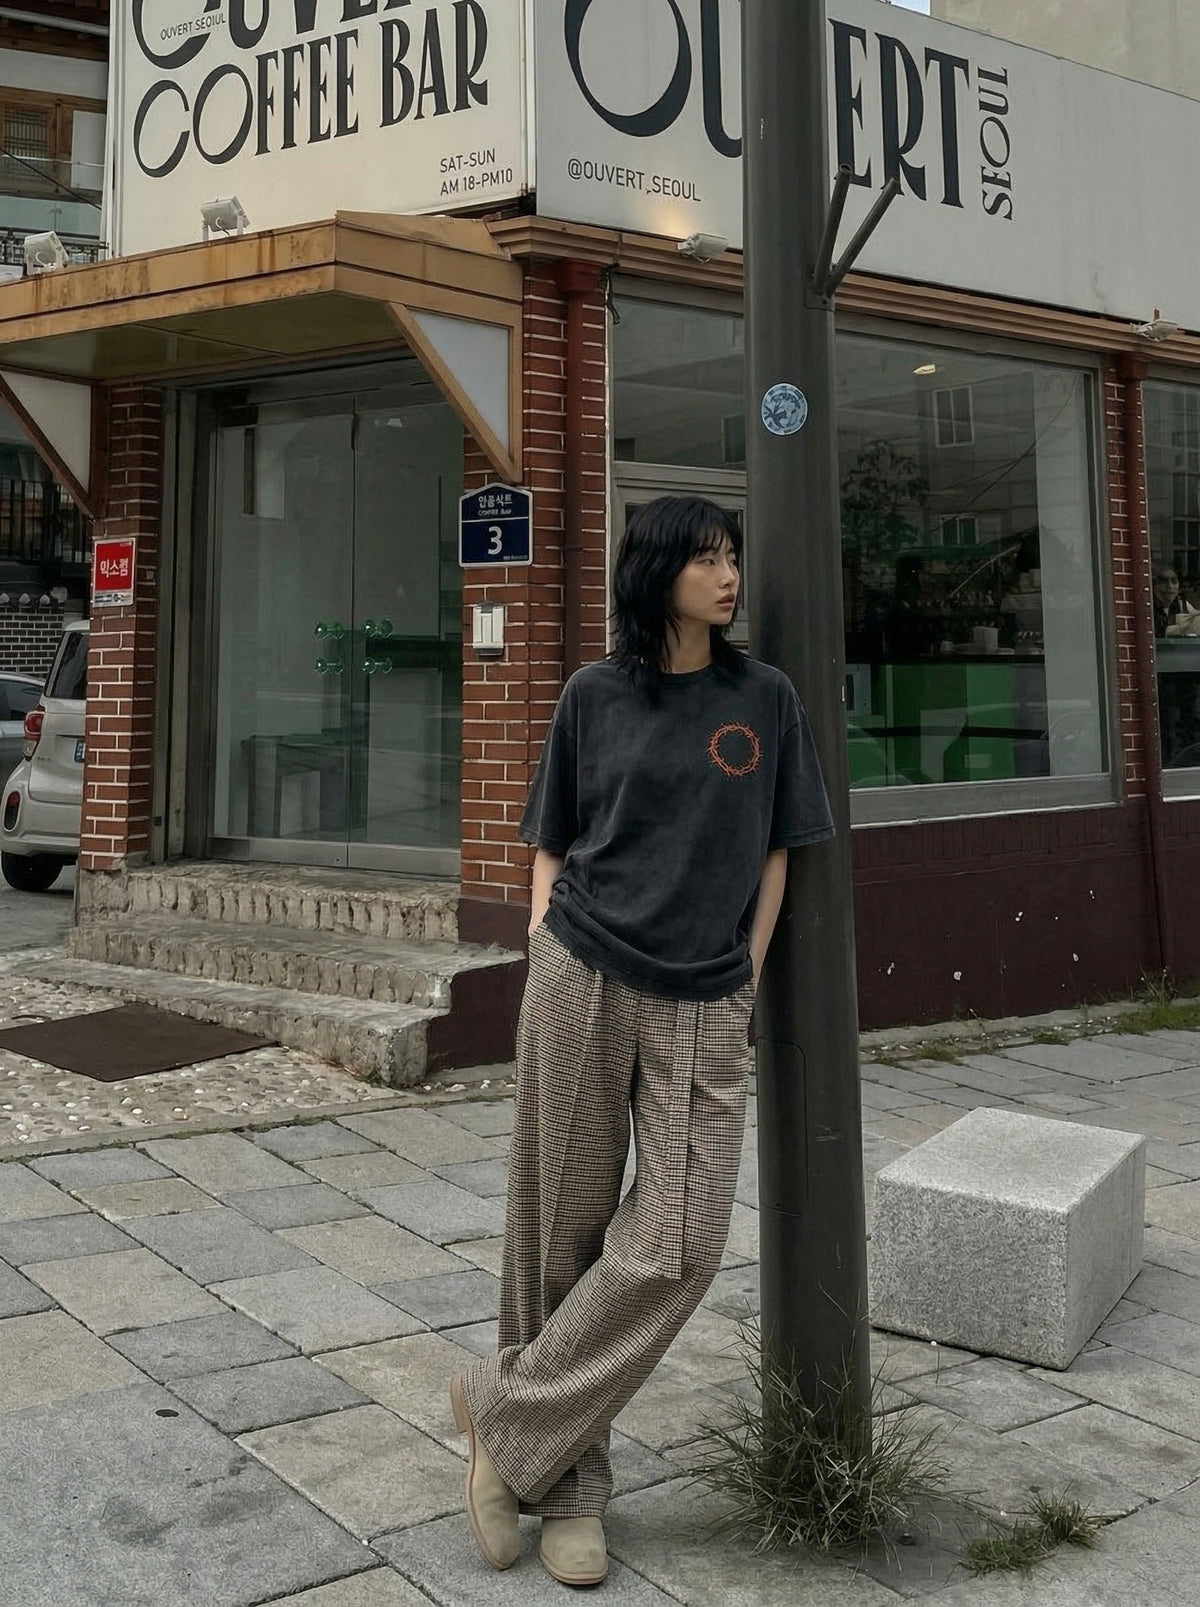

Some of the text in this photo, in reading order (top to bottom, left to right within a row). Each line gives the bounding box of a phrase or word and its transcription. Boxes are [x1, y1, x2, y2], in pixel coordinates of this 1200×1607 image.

[160, 21, 193, 41] OUVERT
[133, 29, 359, 178] COFFEE
[379, 1, 488, 129] BAR
[564, 0, 970, 209] OUERT
[977, 65, 1023, 221] SEOUL
[440, 147, 496, 173] SAT-SUN
[440, 167, 513, 196] AM 18-PM10
[487, 525, 503, 555] 3
